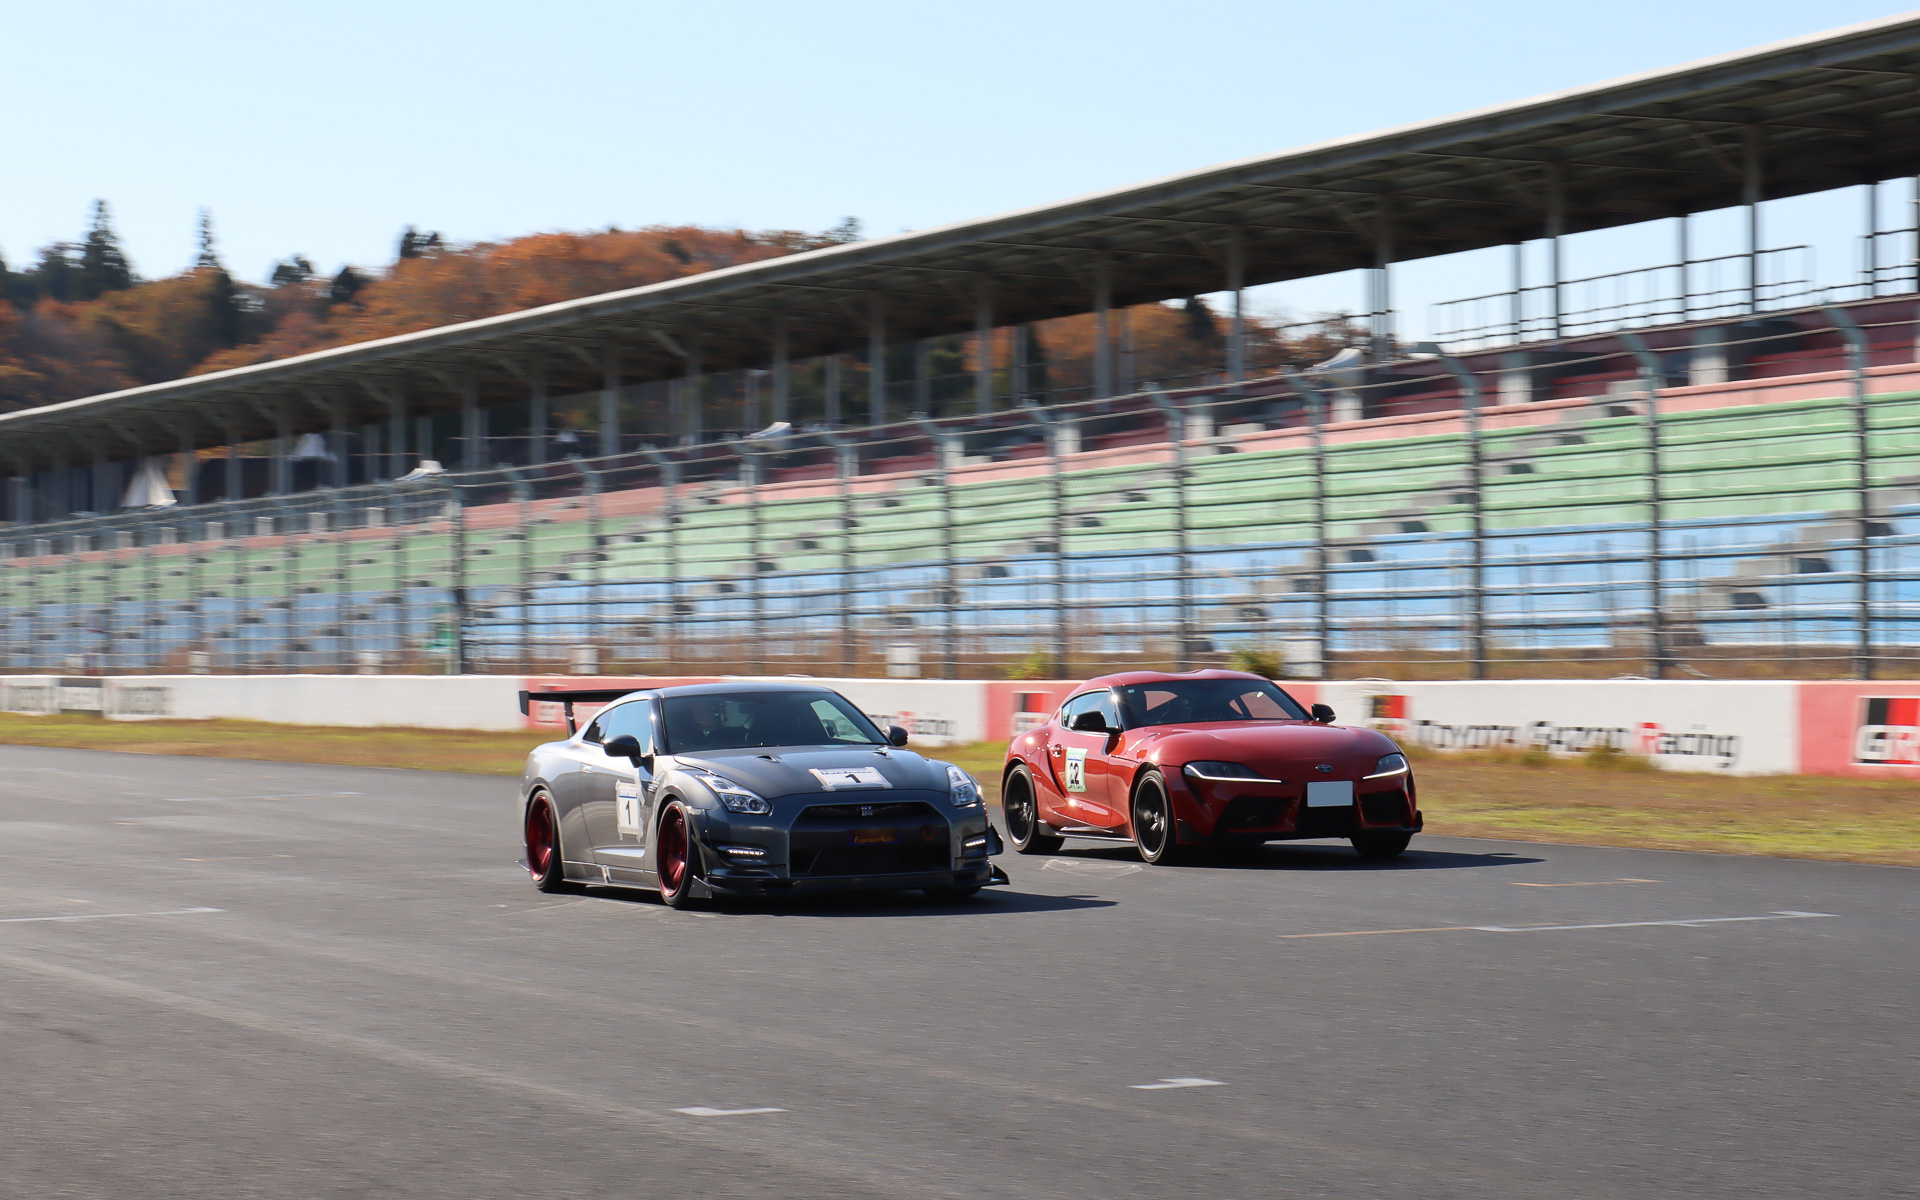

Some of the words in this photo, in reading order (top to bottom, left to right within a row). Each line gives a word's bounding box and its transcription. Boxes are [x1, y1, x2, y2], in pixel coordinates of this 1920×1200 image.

[1635, 721, 1742, 769] Racing
[845, 773, 861, 783] 1
[625, 800, 631, 825] 1
